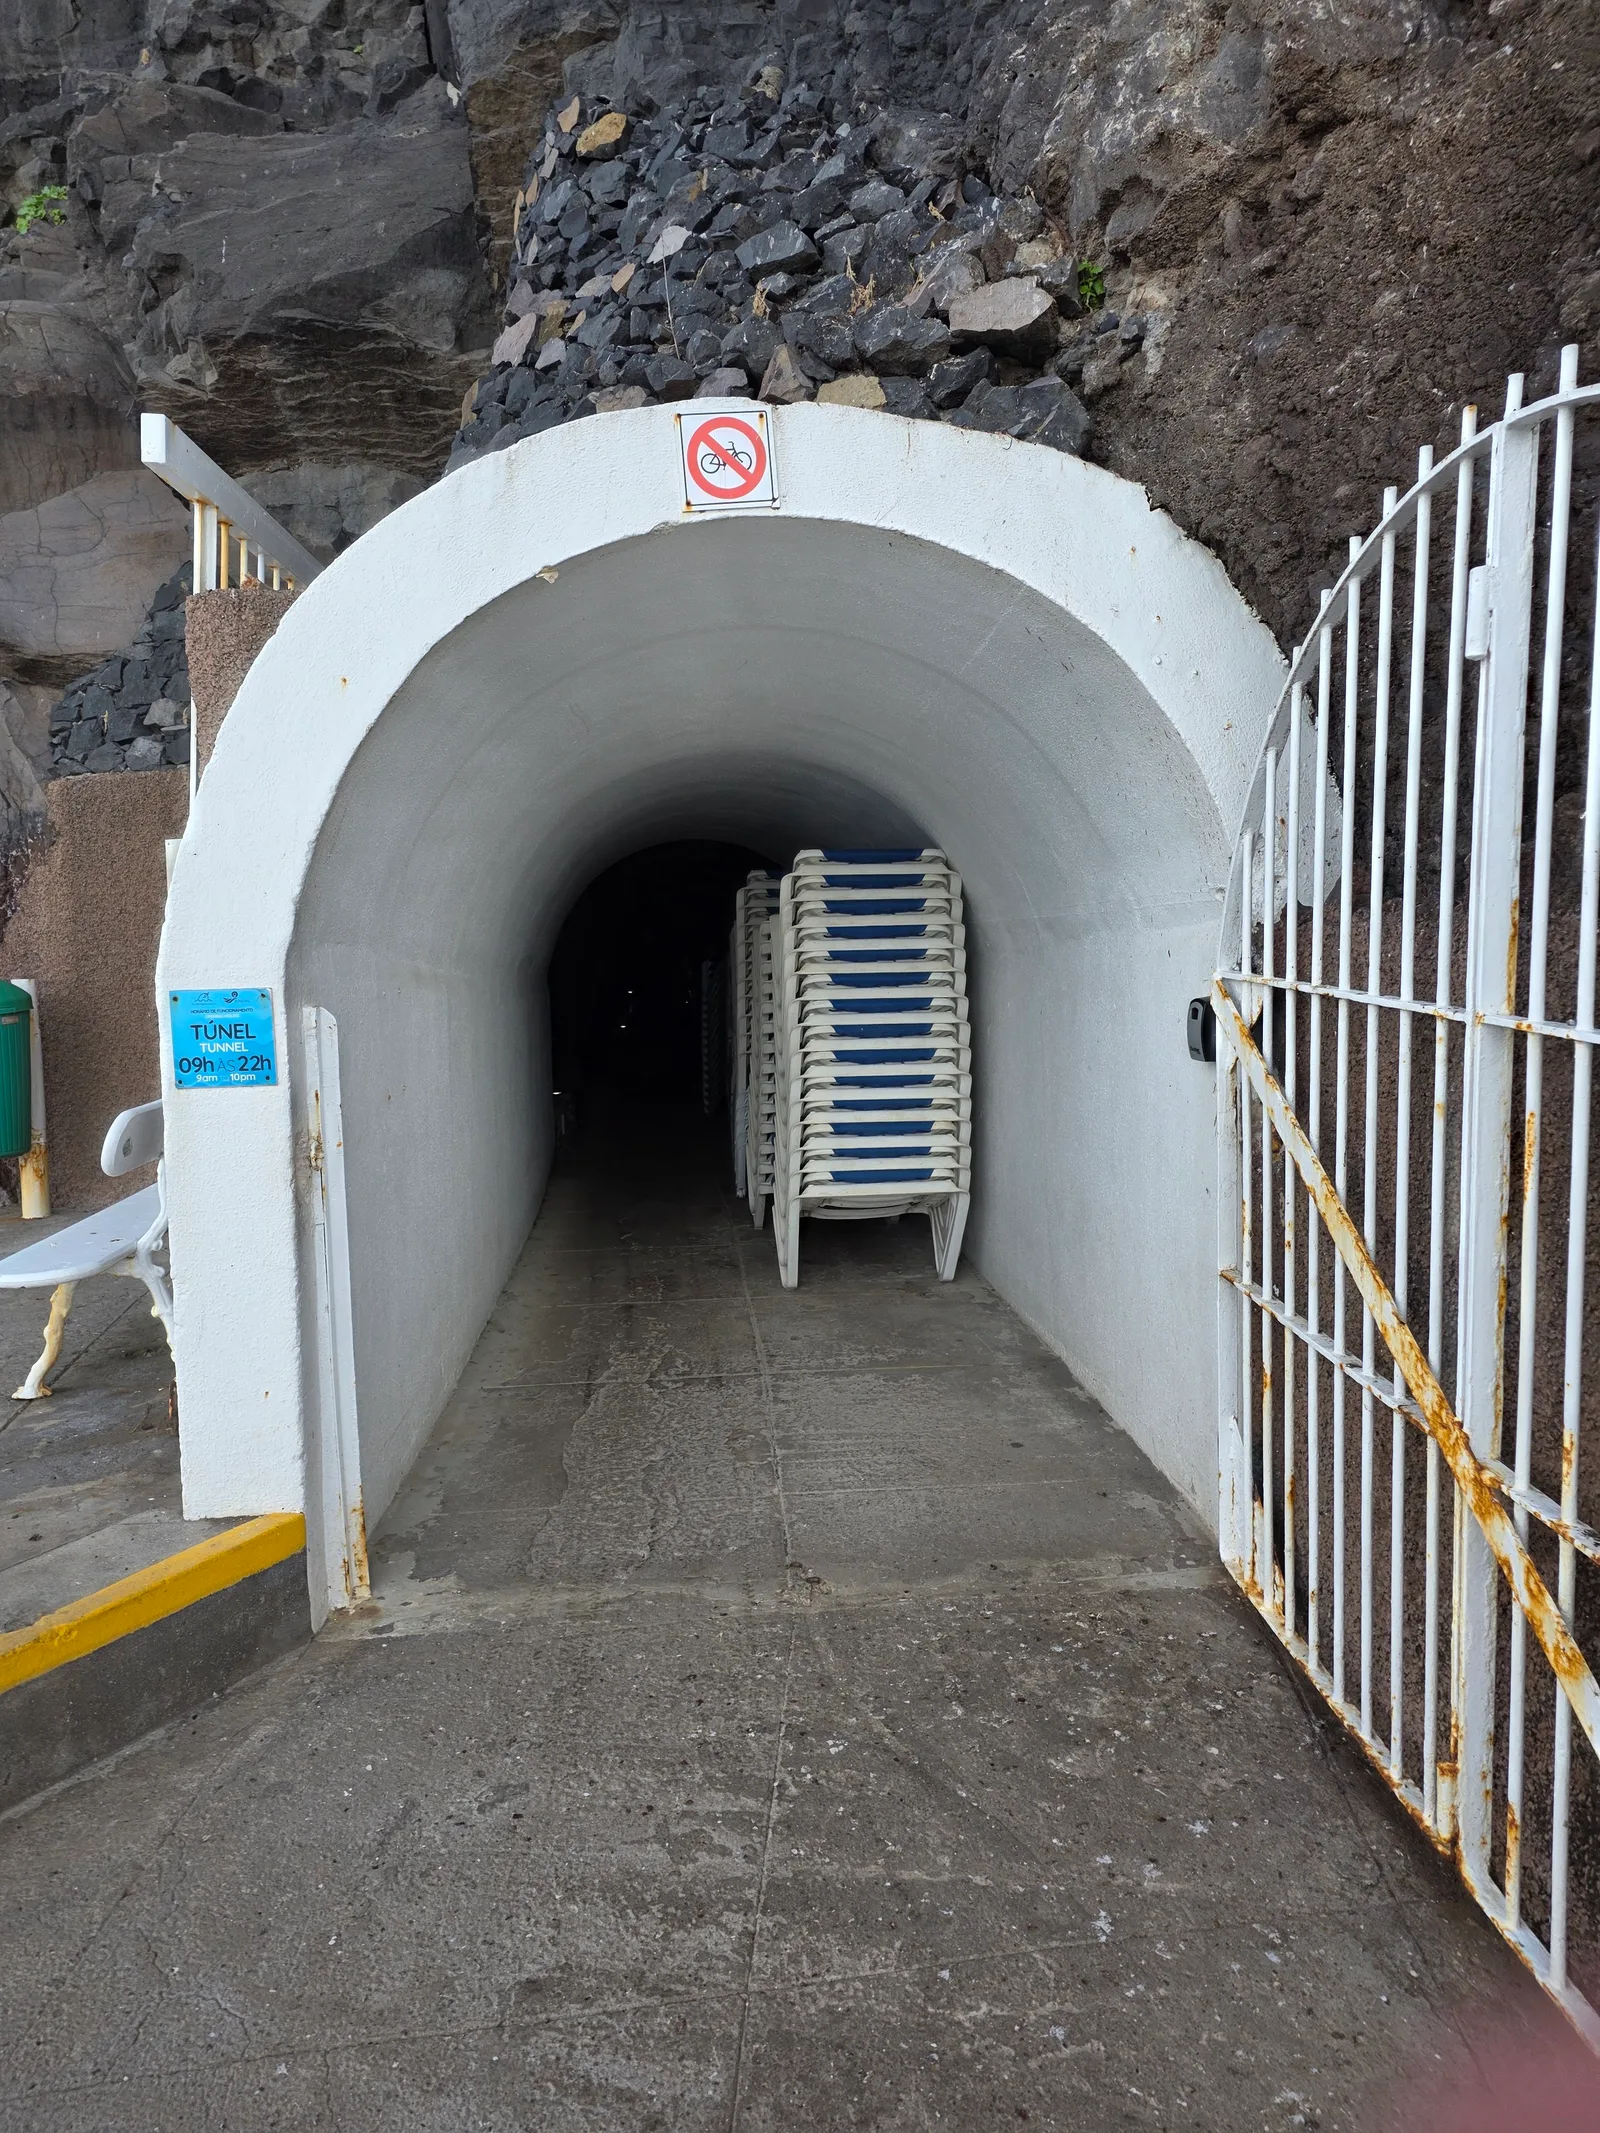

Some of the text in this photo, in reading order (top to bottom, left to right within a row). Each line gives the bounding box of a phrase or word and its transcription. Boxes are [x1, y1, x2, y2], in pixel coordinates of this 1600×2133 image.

[190, 1020, 256, 1040] TÚNEL
[199, 1042, 249, 1053] TUNNEL
[179, 1054, 272, 1074] 09h ÀS 22h
[196, 1074, 218, 1083] 9am
[229, 1073, 256, 1083] 10pm
